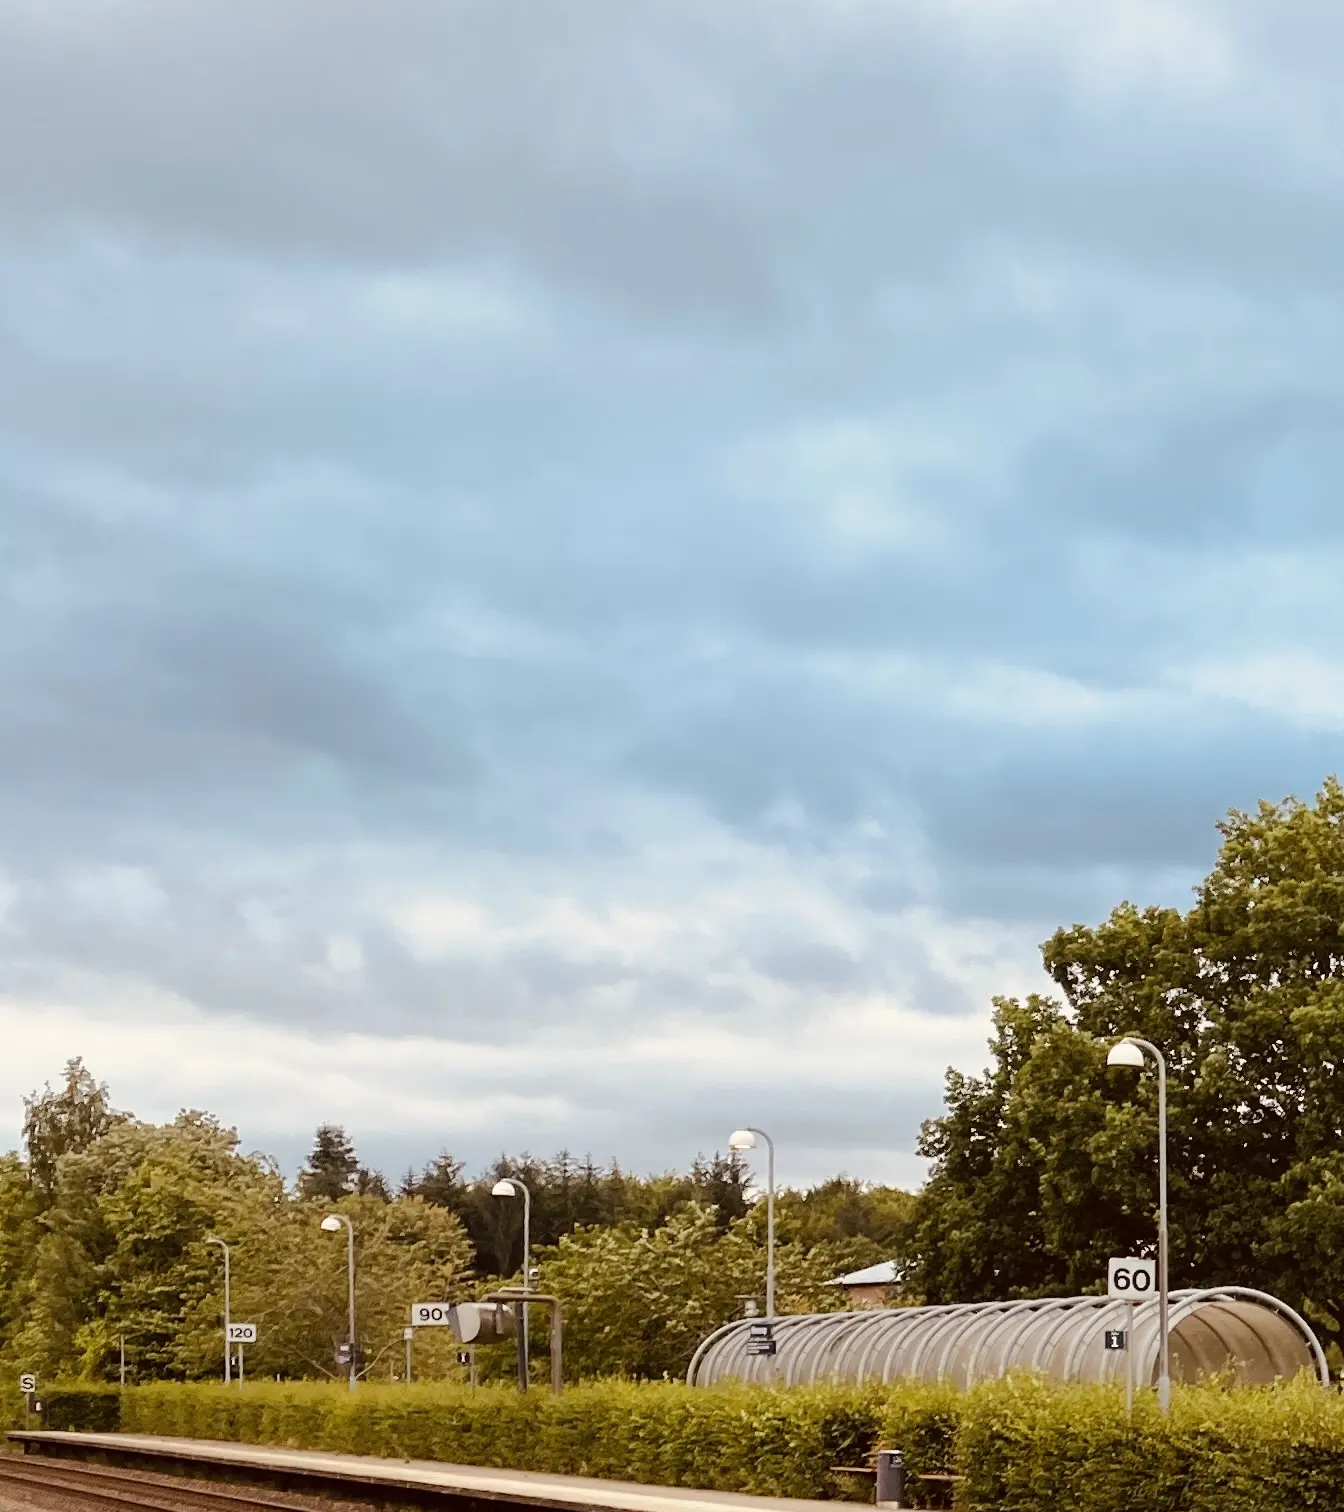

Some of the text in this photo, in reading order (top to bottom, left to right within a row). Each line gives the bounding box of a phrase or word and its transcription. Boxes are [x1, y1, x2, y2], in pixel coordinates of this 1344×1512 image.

[1114, 1268, 1150, 1292] 60
[420, 1308, 442, 1321] 90
[229, 1327, 253, 1339] 120
[1110, 1336, 1119, 1348] 1
[22, 1377, 34, 1390] S
